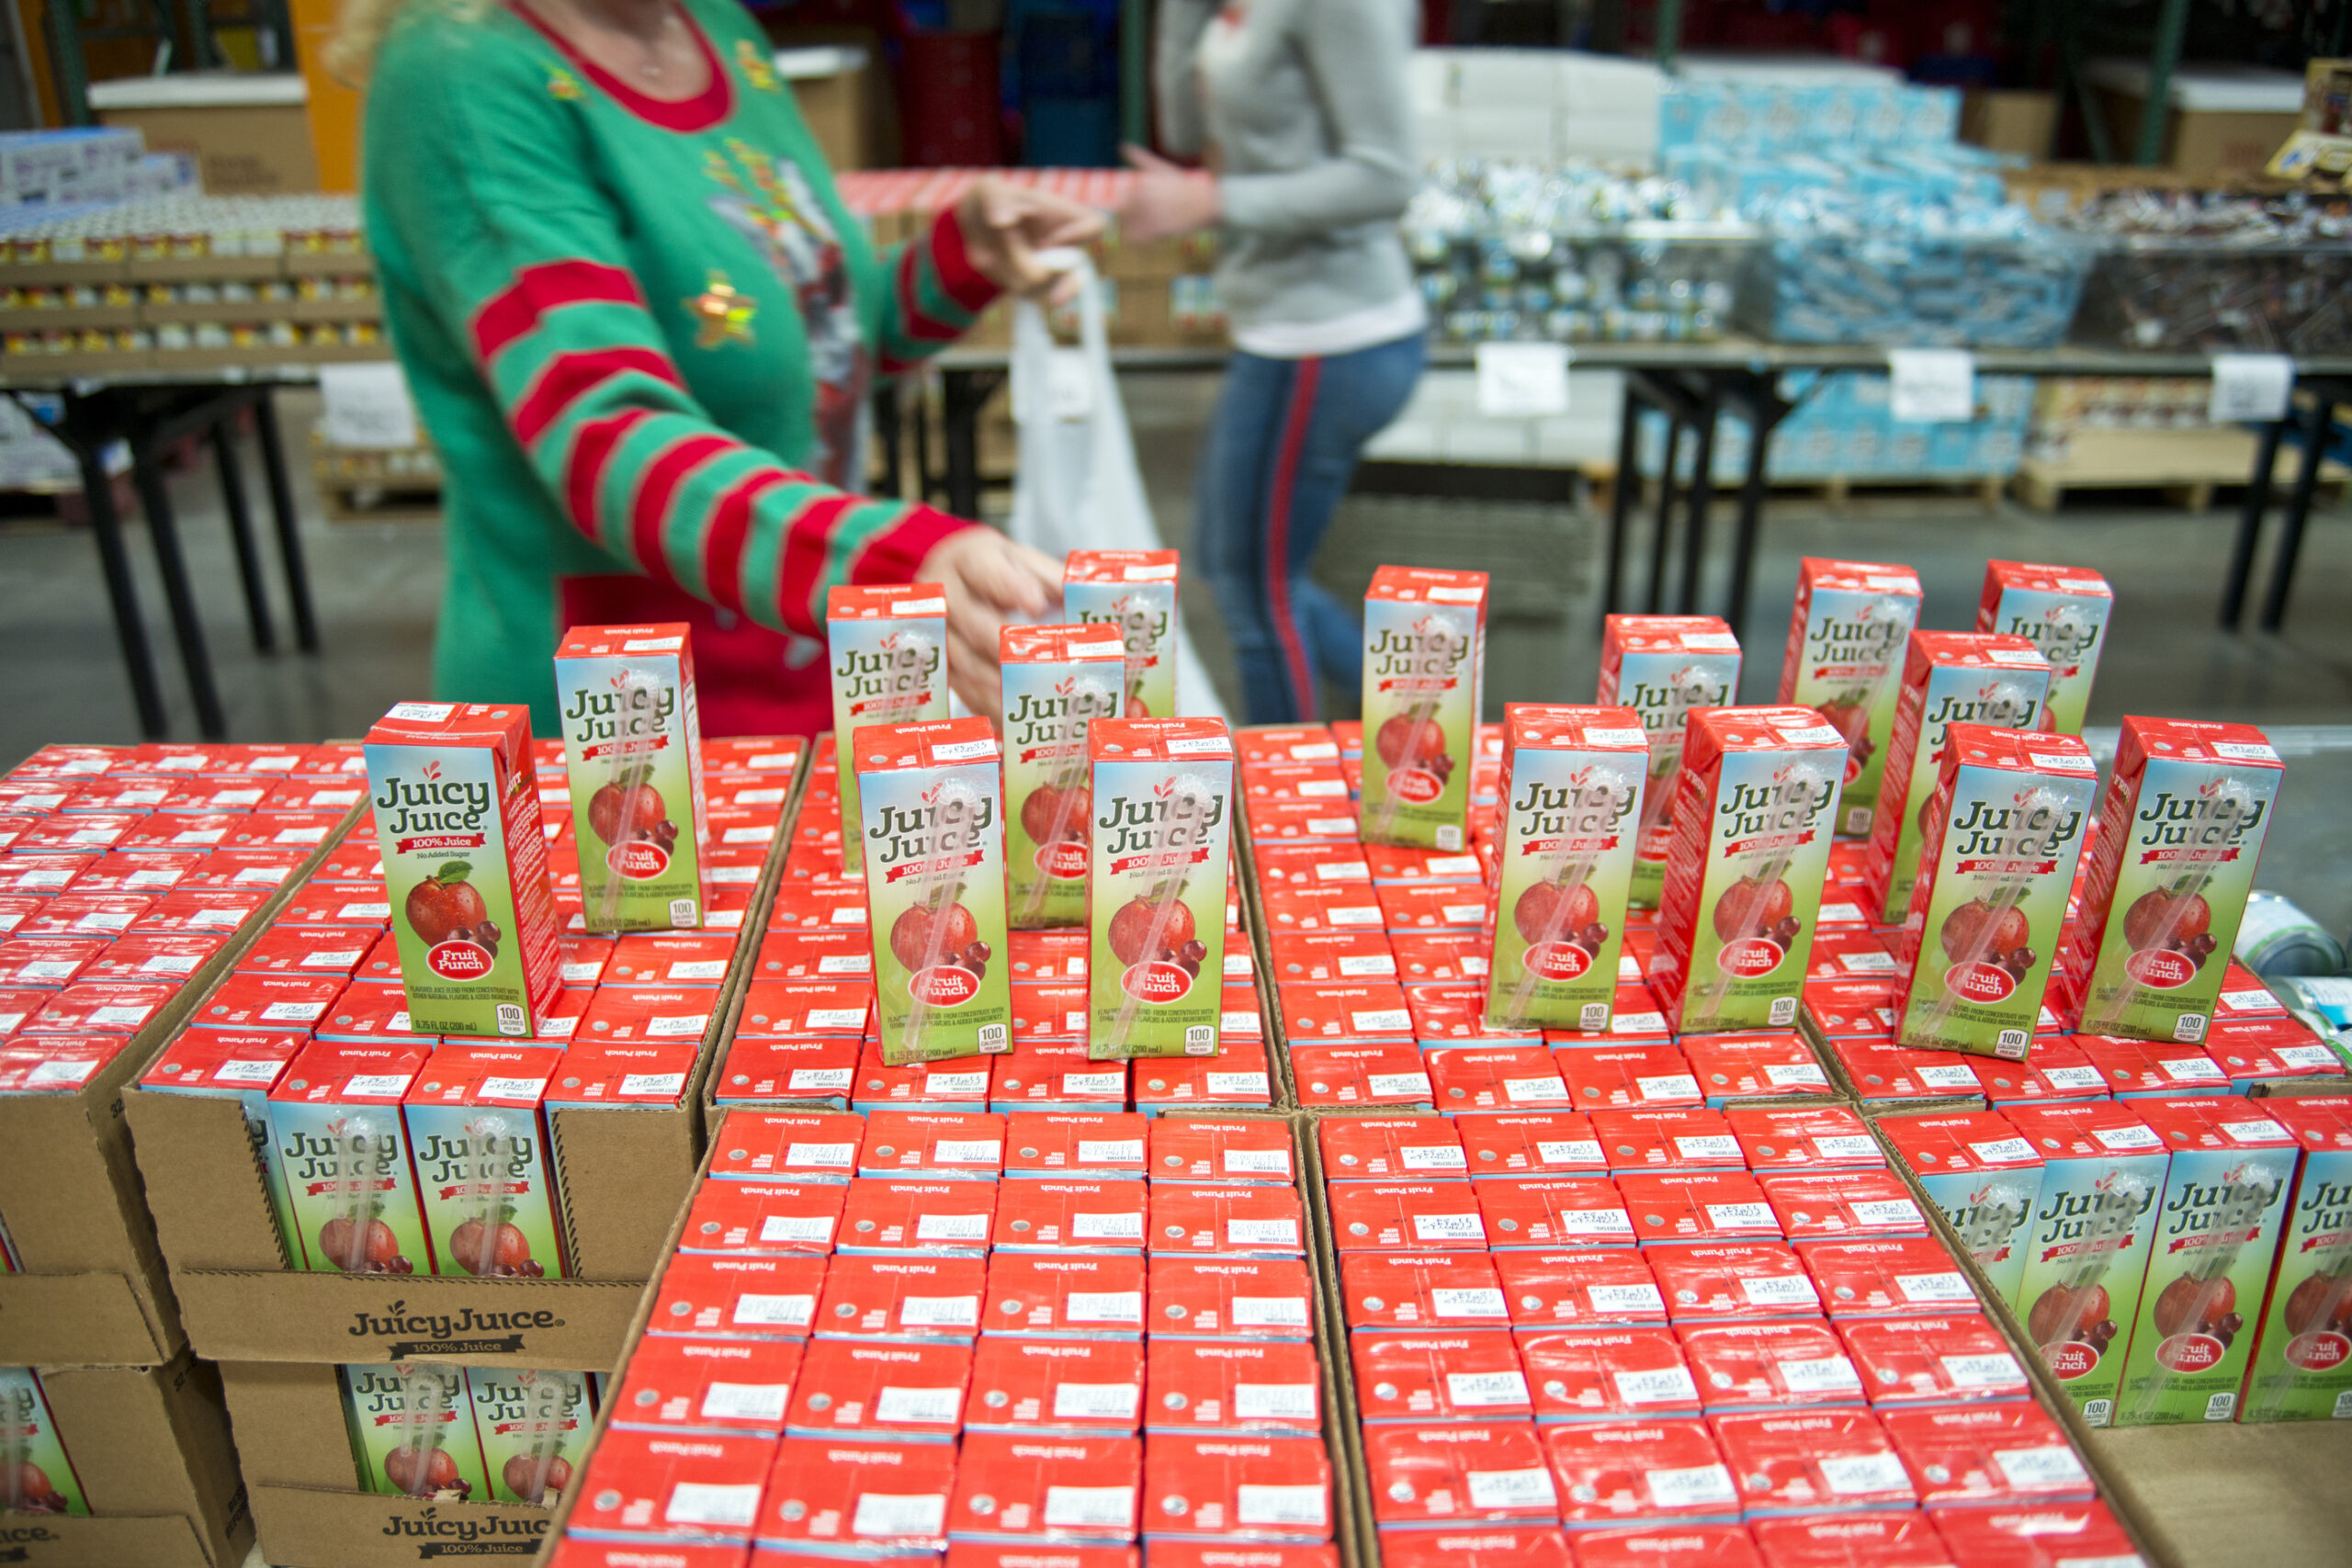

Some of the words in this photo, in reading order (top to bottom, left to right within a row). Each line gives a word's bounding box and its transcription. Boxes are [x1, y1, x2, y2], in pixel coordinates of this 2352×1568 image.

[1810, 616, 1905, 648] Juicy
[1370, 629, 1470, 661] Juicy
[1813, 641, 1893, 664] Juice
[836, 646, 940, 677] Juicy
[566, 687, 673, 719] Juicy
[1008, 692, 1117, 723] Juicy
[1016, 721, 1087, 745] Juic
[377, 777, 490, 814] Juicy
[1515, 783, 1637, 816] Juicy
[869, 797, 991, 839] Juicy
[1099, 795, 1223, 829] Juicy
[390, 807, 481, 833] Juice
[1954, 802, 2082, 840] Juicy
[413, 839, 442, 848] 100%
[444, 838, 471, 846] Juice
[1957, 831, 2059, 857] Juice
[619, 860, 660, 871] unch
[441, 950, 477, 961] Fruit
[1729, 956, 1772, 966] unch
[437, 959, 483, 969] Punch
[1536, 961, 1580, 972] unch
[2146, 960, 2181, 972] ruit
[2139, 967, 2183, 980] unch
[1136, 982, 1181, 992] unch
[1958, 978, 2003, 995] unch
[1774, 1000, 1793, 1012] 100
[500, 1008, 520, 1020] 100
[1585, 1007, 1604, 1018] 100
[2181, 1016, 2201, 1029] 100
[982, 1027, 1001, 1040] 100
[1189, 1029, 1210, 1041] 100
[2002, 1032, 2023, 1045] 100
[470, 1053, 498, 1061] Punch
[499, 1053, 522, 1061] Fruit
[2167, 1100, 2194, 1109] Punch
[2195, 1100, 2218, 1109] Fruit
[2041, 1108, 2068, 1116] Punch
[2069, 1108, 2092, 1116] Fruit
[908, 1115, 937, 1123] Punch
[938, 1115, 963, 1123] Fruit
[1362, 1121, 1391, 1129] Punch
[1392, 1121, 1417, 1129] Fruit
[1919, 1119, 1946, 1127] Punch
[1948, 1119, 1970, 1127] Fruit
[285, 1133, 399, 1161] Jucy
[419, 1134, 533, 1165] Jucy
[298, 1156, 390, 1179] Juce
[741, 1187, 773, 1196] Punch
[774, 1187, 800, 1196] Fruit
[890, 1185, 922, 1193] Punch
[923, 1185, 949, 1193] Fruit
[1041, 1184, 1072, 1192] Punch
[1074, 1184, 1100, 1192] Fruit
[1939, 1198, 2032, 1228] uicy
[413, 1343, 458, 1353] 100%
[459, 1342, 503, 1352] Juice
[2176, 1352, 2212, 1362] unch
[2051, 1359, 2087, 1370] unch
[356, 1372, 460, 1397] Jucy
[476, 1381, 582, 1405] Jucy
[368, 1393, 453, 1412] Juce
[2211, 1395, 2231, 1406] 100
[488, 1403, 574, 1422] Juce
[2086, 1402, 2107, 1414] 100
[441, 1545, 481, 1553] 100%
[483, 1544, 524, 1553] Juice
